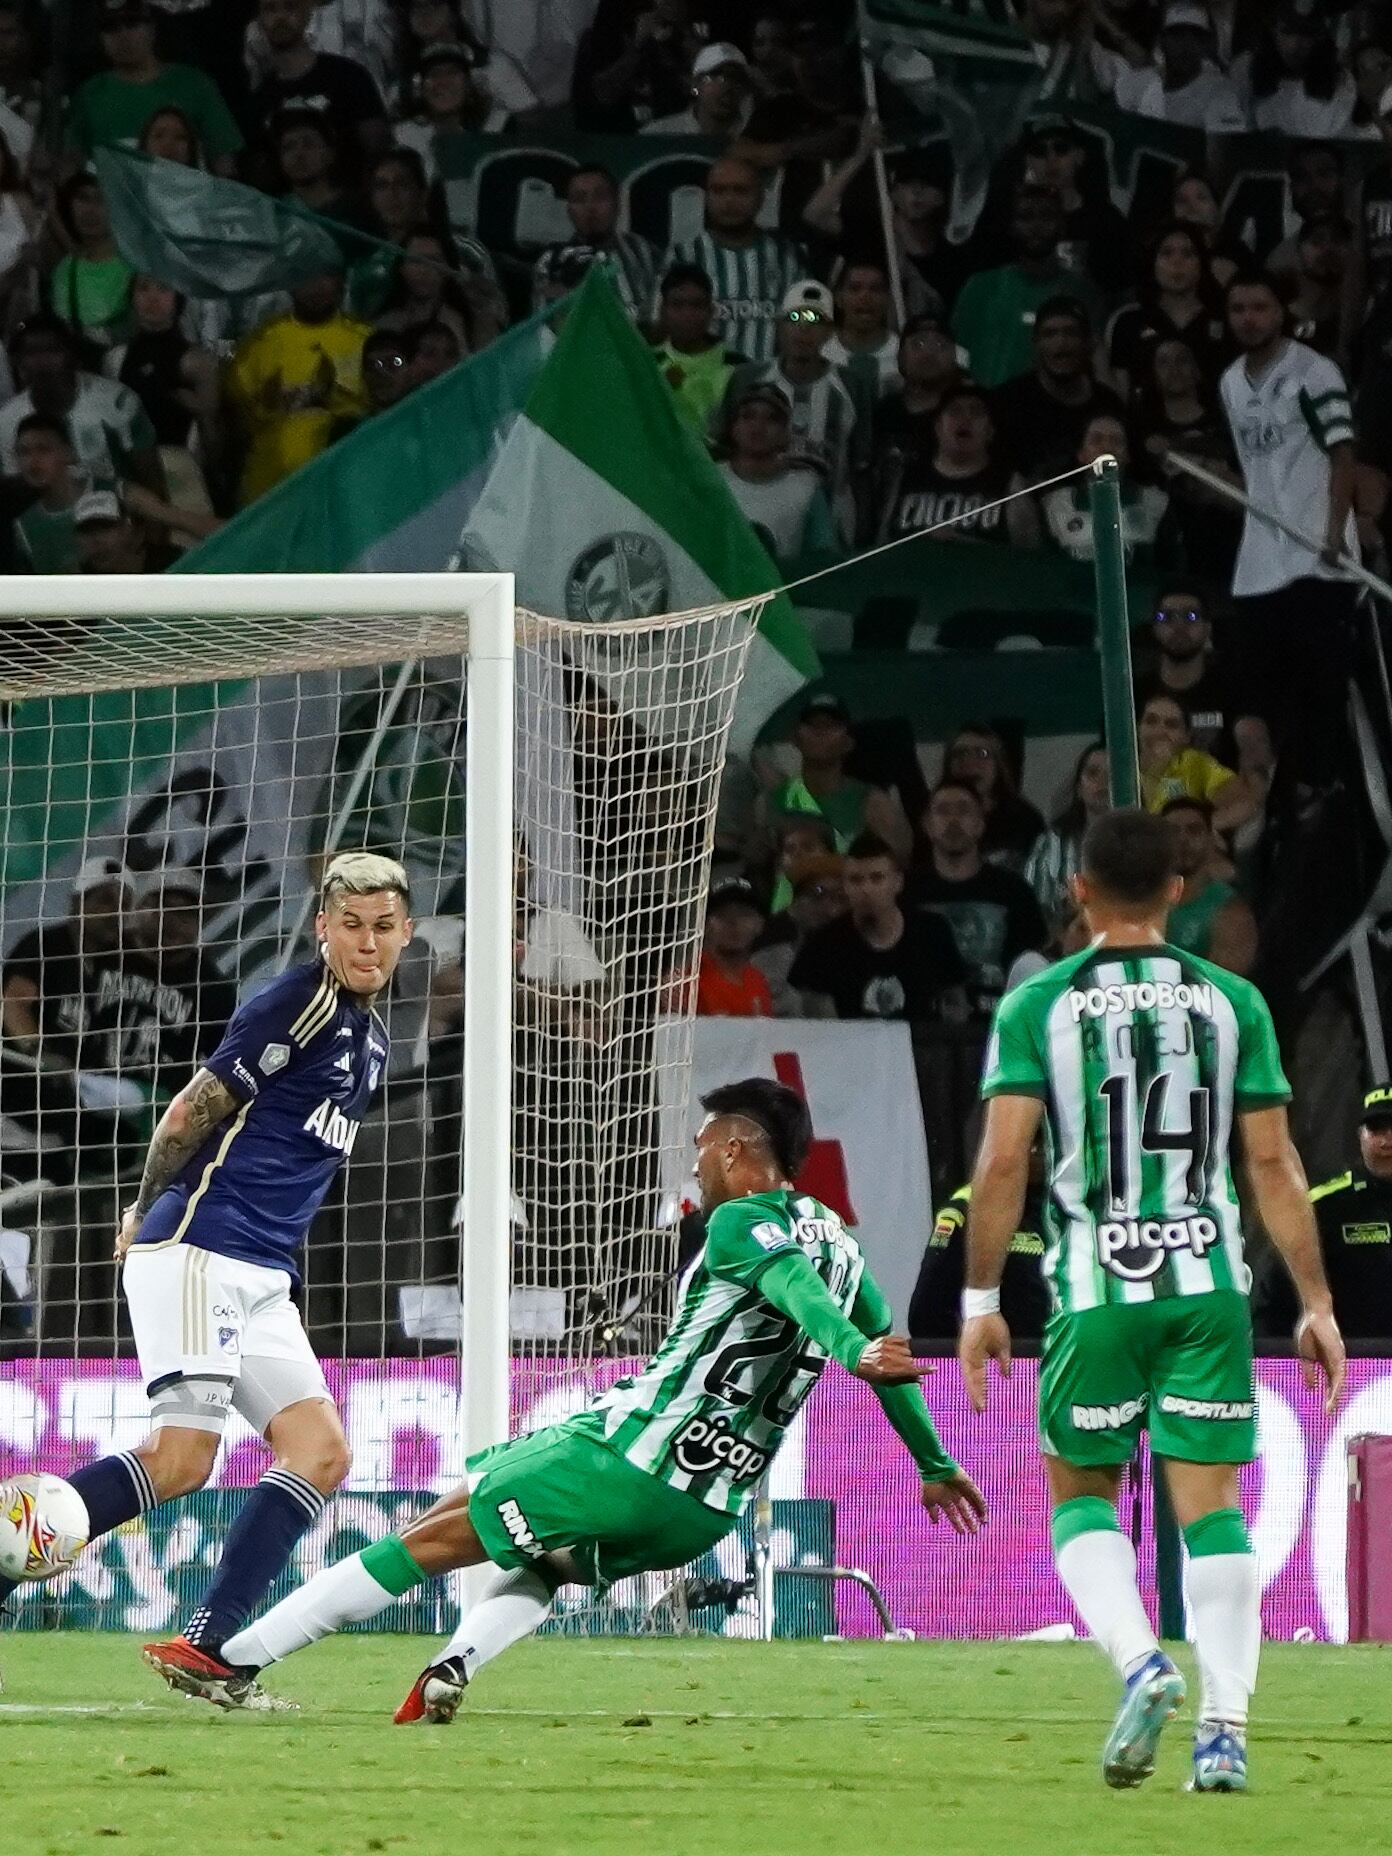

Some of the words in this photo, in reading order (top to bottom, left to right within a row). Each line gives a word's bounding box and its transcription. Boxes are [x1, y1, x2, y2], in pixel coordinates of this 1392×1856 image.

[1069, 982, 1213, 1022] POSTOBON
[1097, 1071, 1210, 1214] 14
[1098, 1216, 1218, 1265] picap
[674, 1418, 766, 1480] picap
